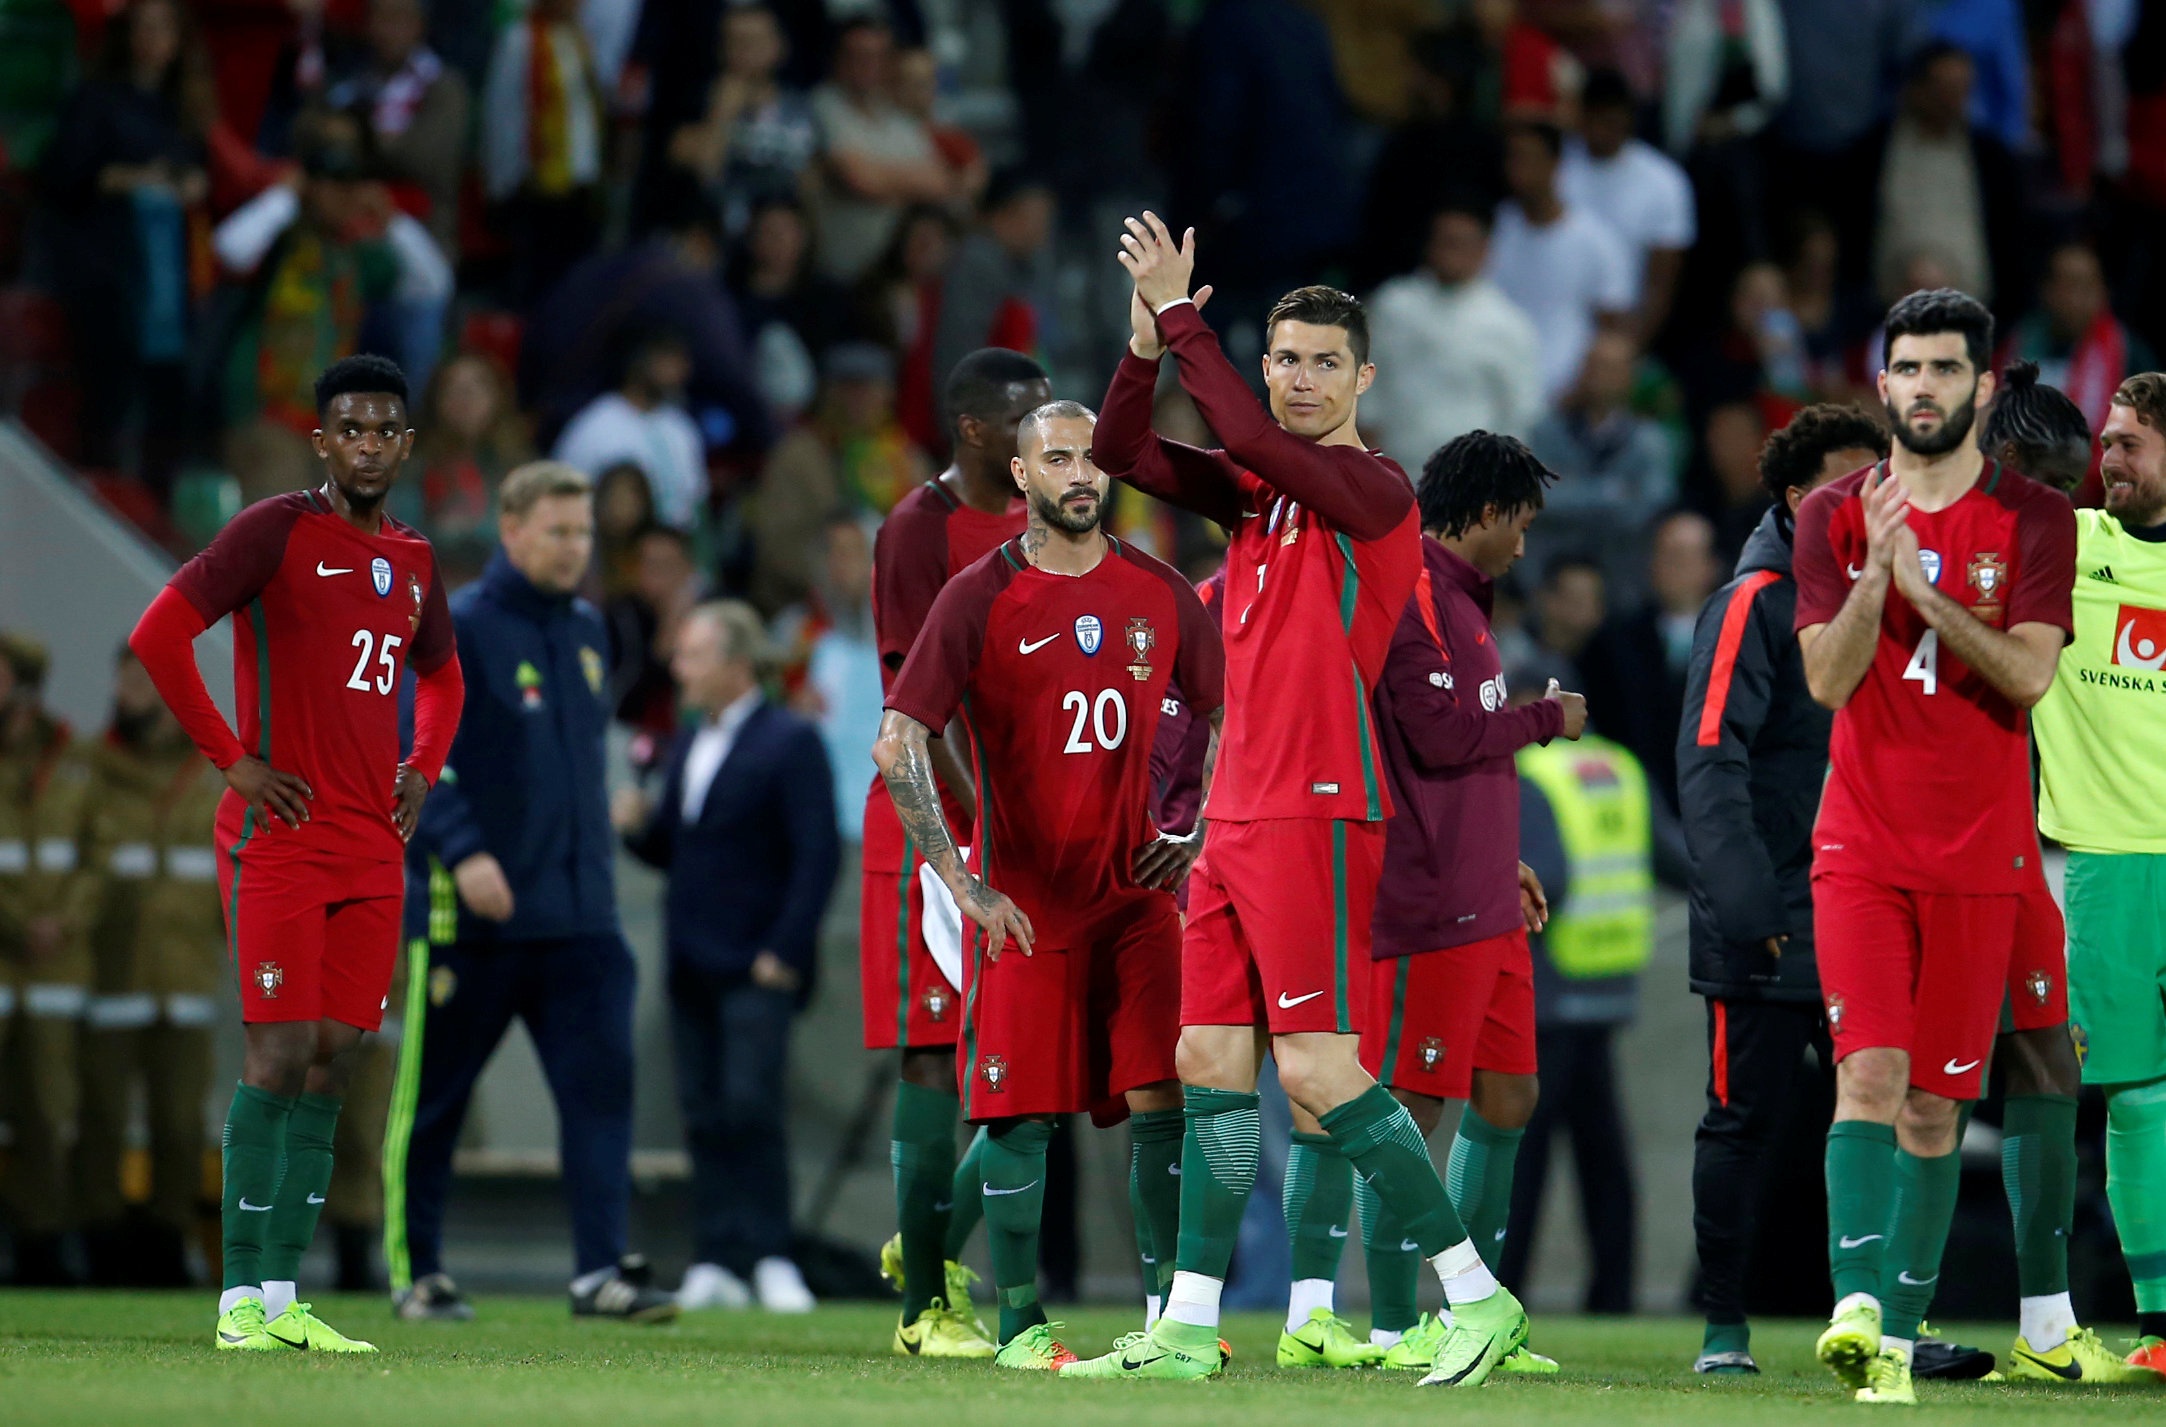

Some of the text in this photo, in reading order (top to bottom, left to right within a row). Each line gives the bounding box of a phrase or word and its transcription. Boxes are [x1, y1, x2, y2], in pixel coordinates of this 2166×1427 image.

[346, 629, 402, 696] 25
[1902, 628, 1938, 695] 4
[2080, 668, 2155, 692] SVENSKA
[1062, 688, 1127, 754] 20
[1161, 698, 1180, 717] ES
[1175, 1352, 1192, 1363] CR7
